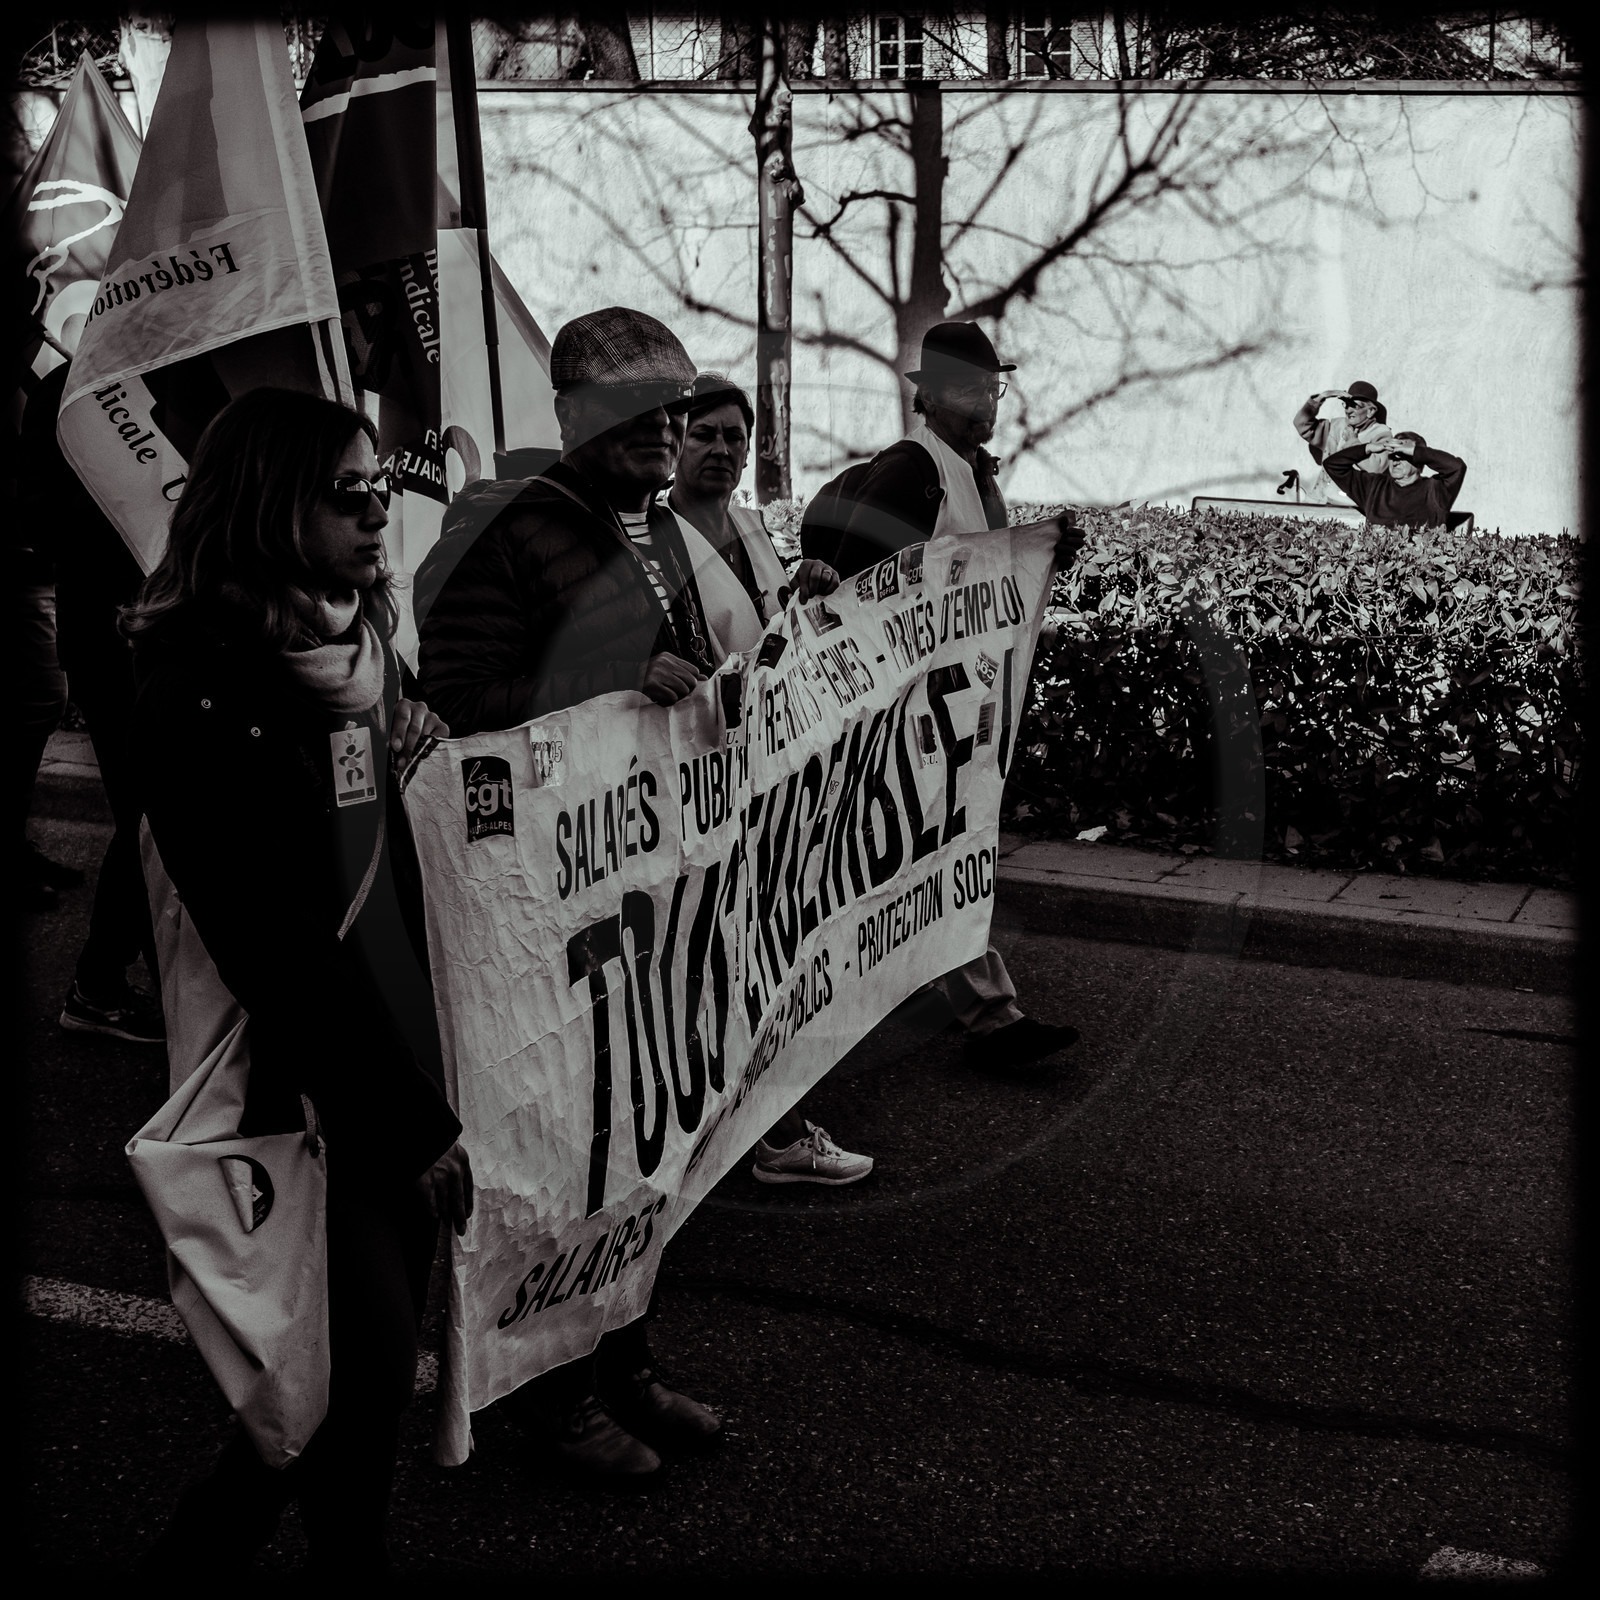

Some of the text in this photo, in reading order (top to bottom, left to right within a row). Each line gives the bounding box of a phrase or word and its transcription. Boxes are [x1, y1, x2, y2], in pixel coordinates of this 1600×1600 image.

[400, 256, 440, 364] ndicale
[880, 561, 894, 591] FO
[466, 778, 513, 817] cgt
[556, 755, 660, 900] SALARÉS
[940, 574, 1026, 644] D'EMPLOI
[497, 1194, 668, 1330] SALAIRES
[857, 868, 943, 978] PROTECTION
[567, 838, 738, 1220] TOUS
